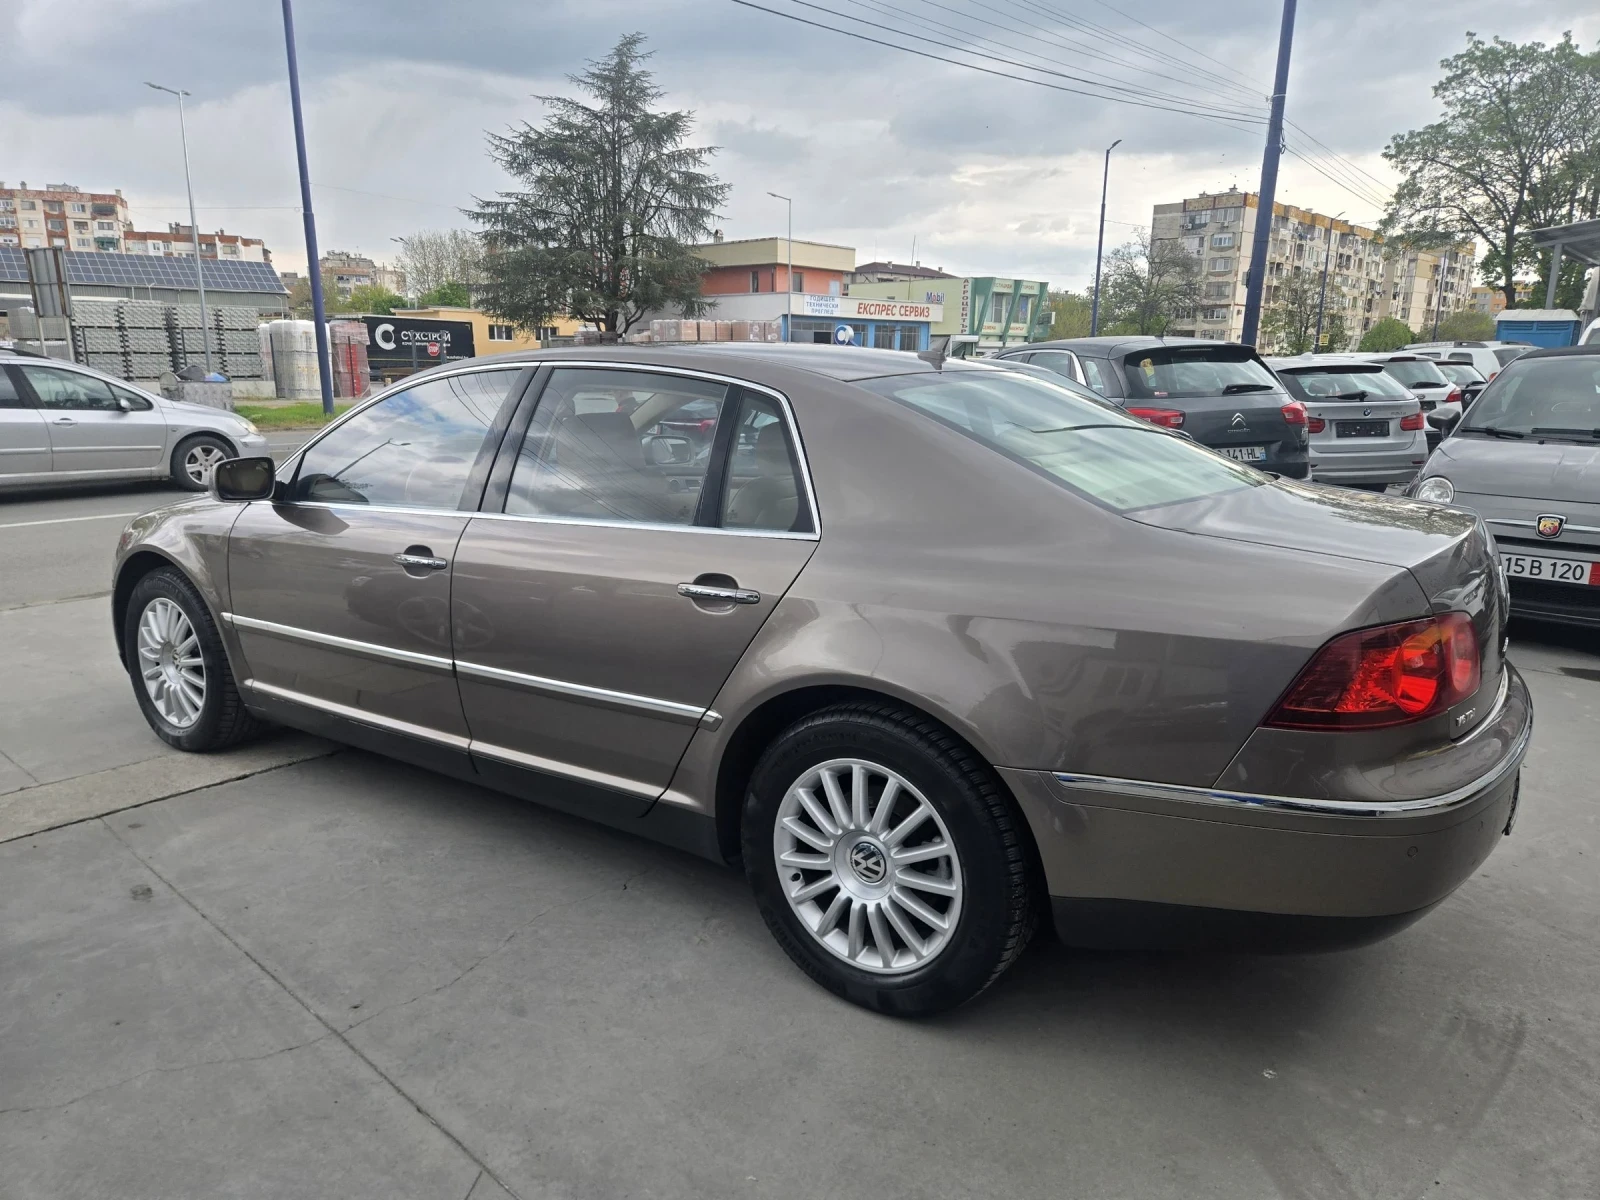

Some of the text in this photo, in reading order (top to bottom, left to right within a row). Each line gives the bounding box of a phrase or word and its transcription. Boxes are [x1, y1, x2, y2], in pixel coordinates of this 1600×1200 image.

[926, 291, 945, 302] Mobil
[857, 302, 930, 318] ЕКСПРЕС СЕРВИЗ
[1529, 560, 1543, 576] B
[1550, 562, 1585, 581] 120
